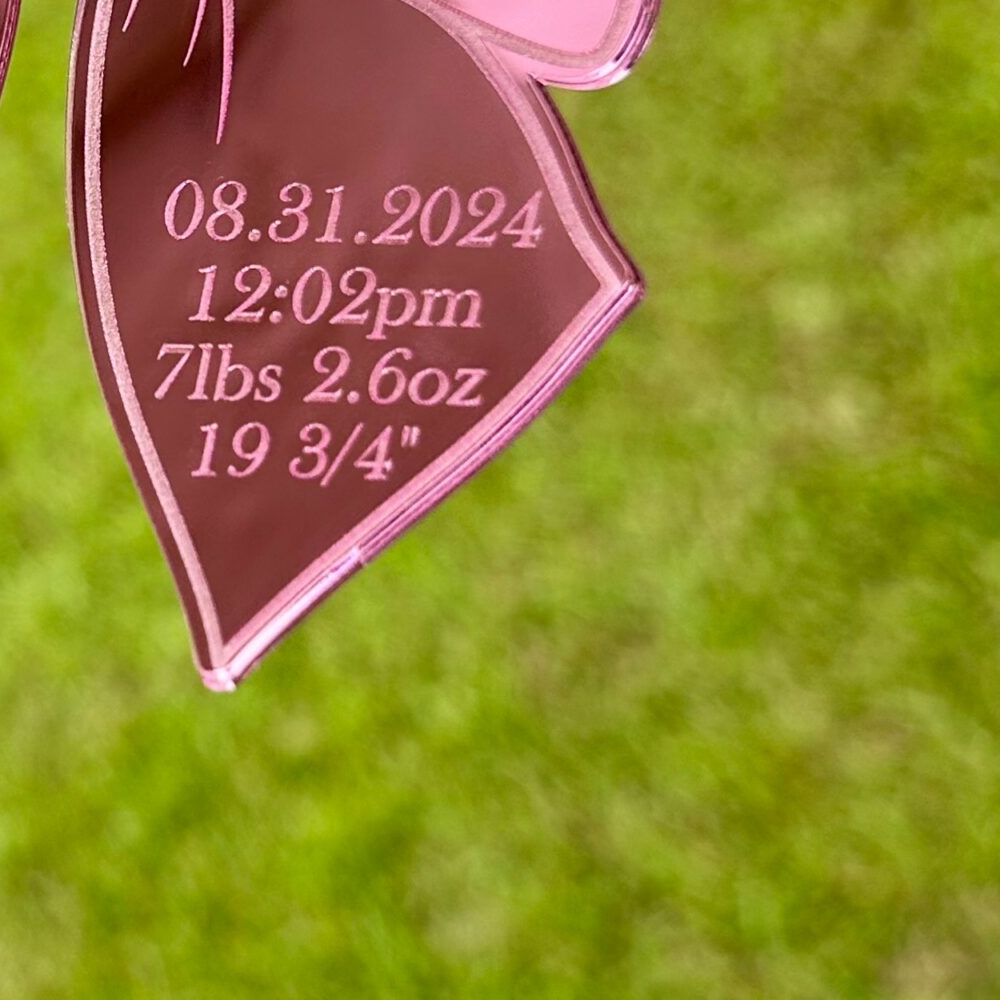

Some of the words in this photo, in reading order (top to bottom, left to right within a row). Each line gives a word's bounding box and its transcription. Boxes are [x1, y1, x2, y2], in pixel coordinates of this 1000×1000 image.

[164, 179, 543, 249] 08.31.2024
[188, 264, 483, 340] 12:02pm
[153, 342, 283, 402] 7lbs
[303, 345, 491, 407] 2.6oz
[190, 421, 271, 478] 19
[288, 421, 421, 487] 3/4"
